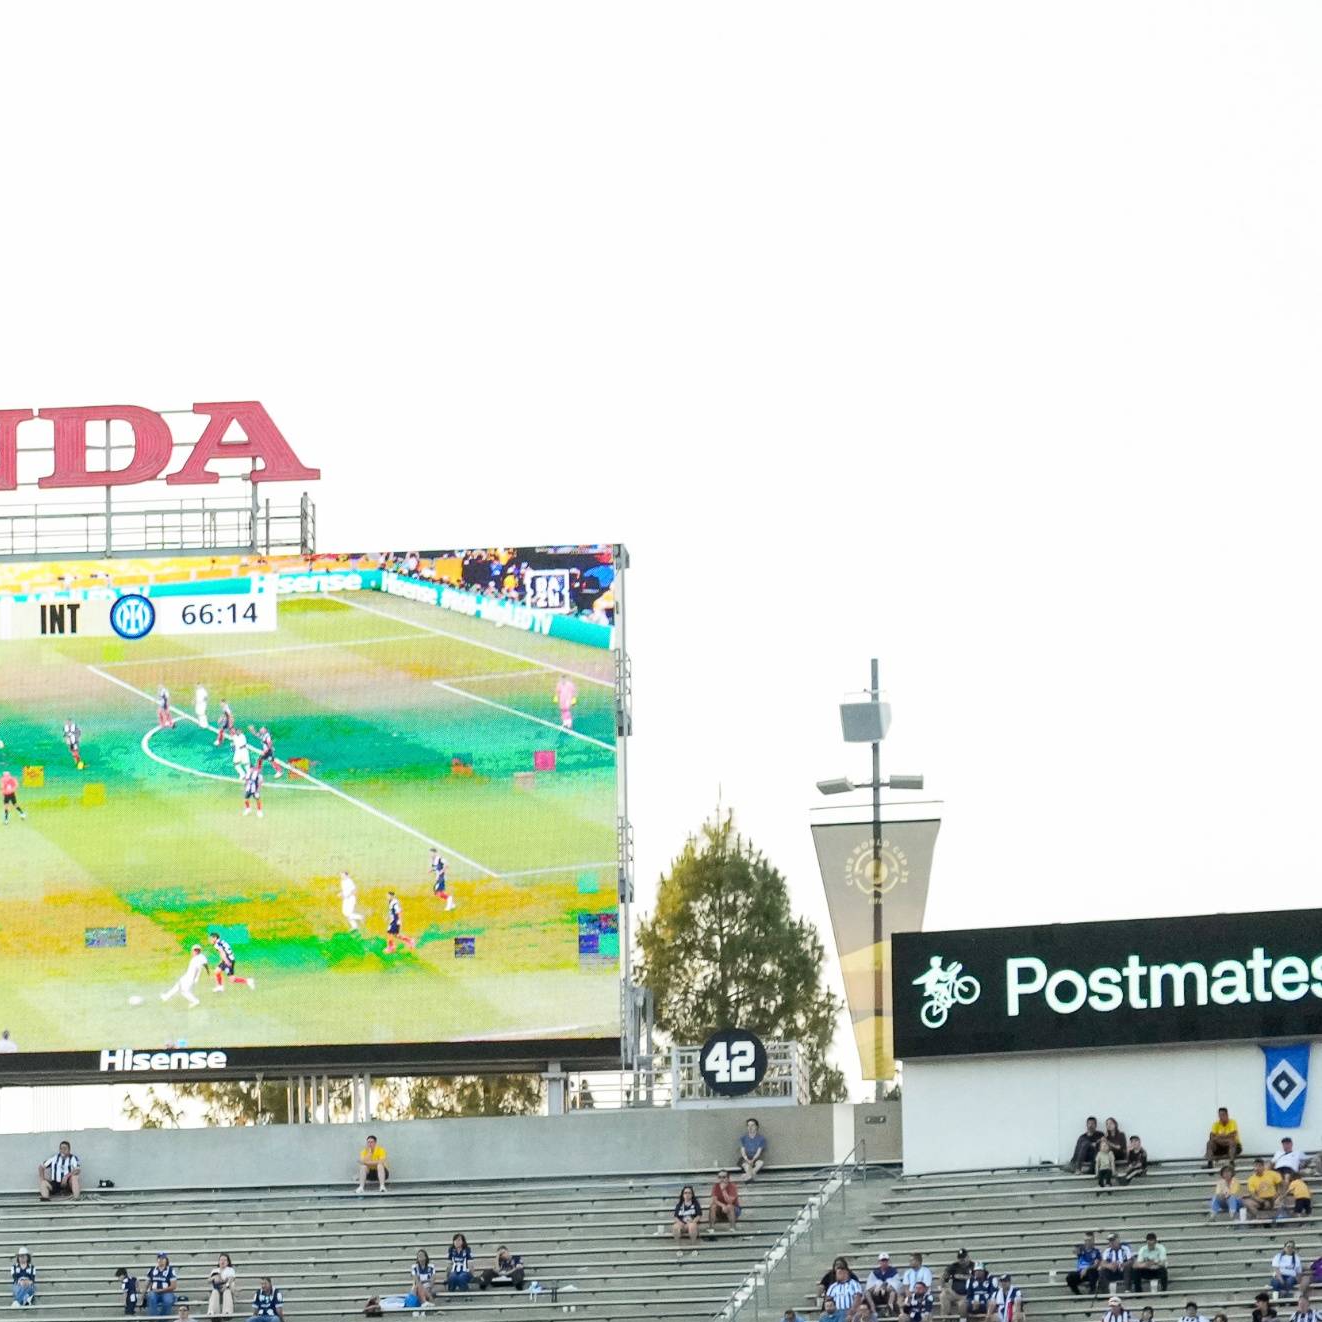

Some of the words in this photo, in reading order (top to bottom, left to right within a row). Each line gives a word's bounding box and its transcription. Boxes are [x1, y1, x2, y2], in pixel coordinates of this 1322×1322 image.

[40, 603, 80, 635] INT
[181, 601, 258, 626] 66:14
[99, 1049, 227, 1072] Hisense
[704, 1040, 756, 1083] 42
